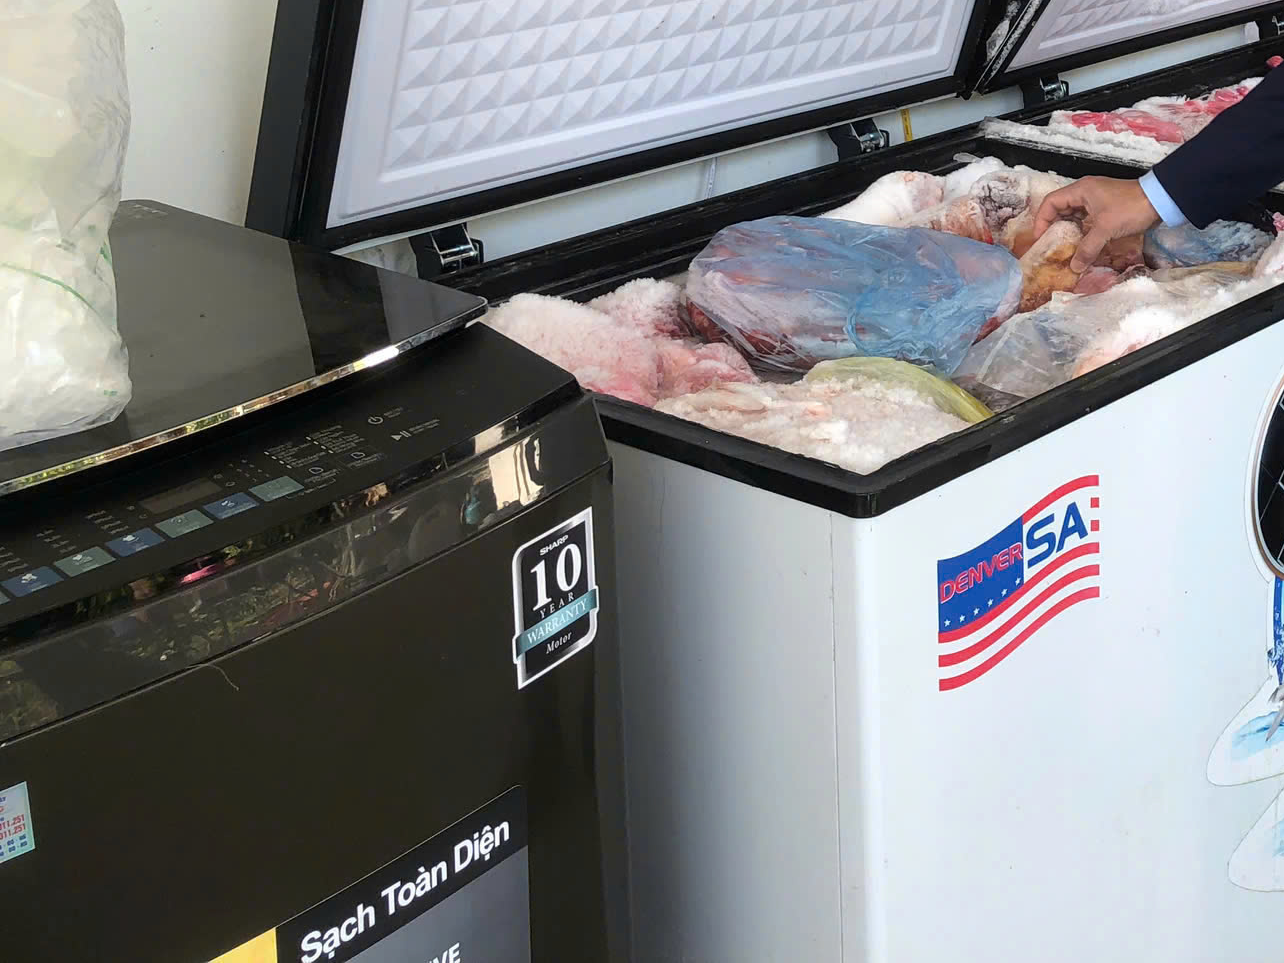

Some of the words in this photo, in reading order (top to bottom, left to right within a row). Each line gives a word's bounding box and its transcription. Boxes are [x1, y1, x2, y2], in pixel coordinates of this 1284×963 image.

[539, 534, 569, 556] SHARP
[530, 543, 582, 611] 10
[940, 542, 1024, 604] DENVER
[527, 598, 588, 644] WARRANTY
[540, 591, 575, 619] YEAR
[546, 631, 573, 655] Motor
[301, 903, 376, 963] Sạch
[381, 860, 448, 916] Toàn
[454, 821, 510, 873] Diện
